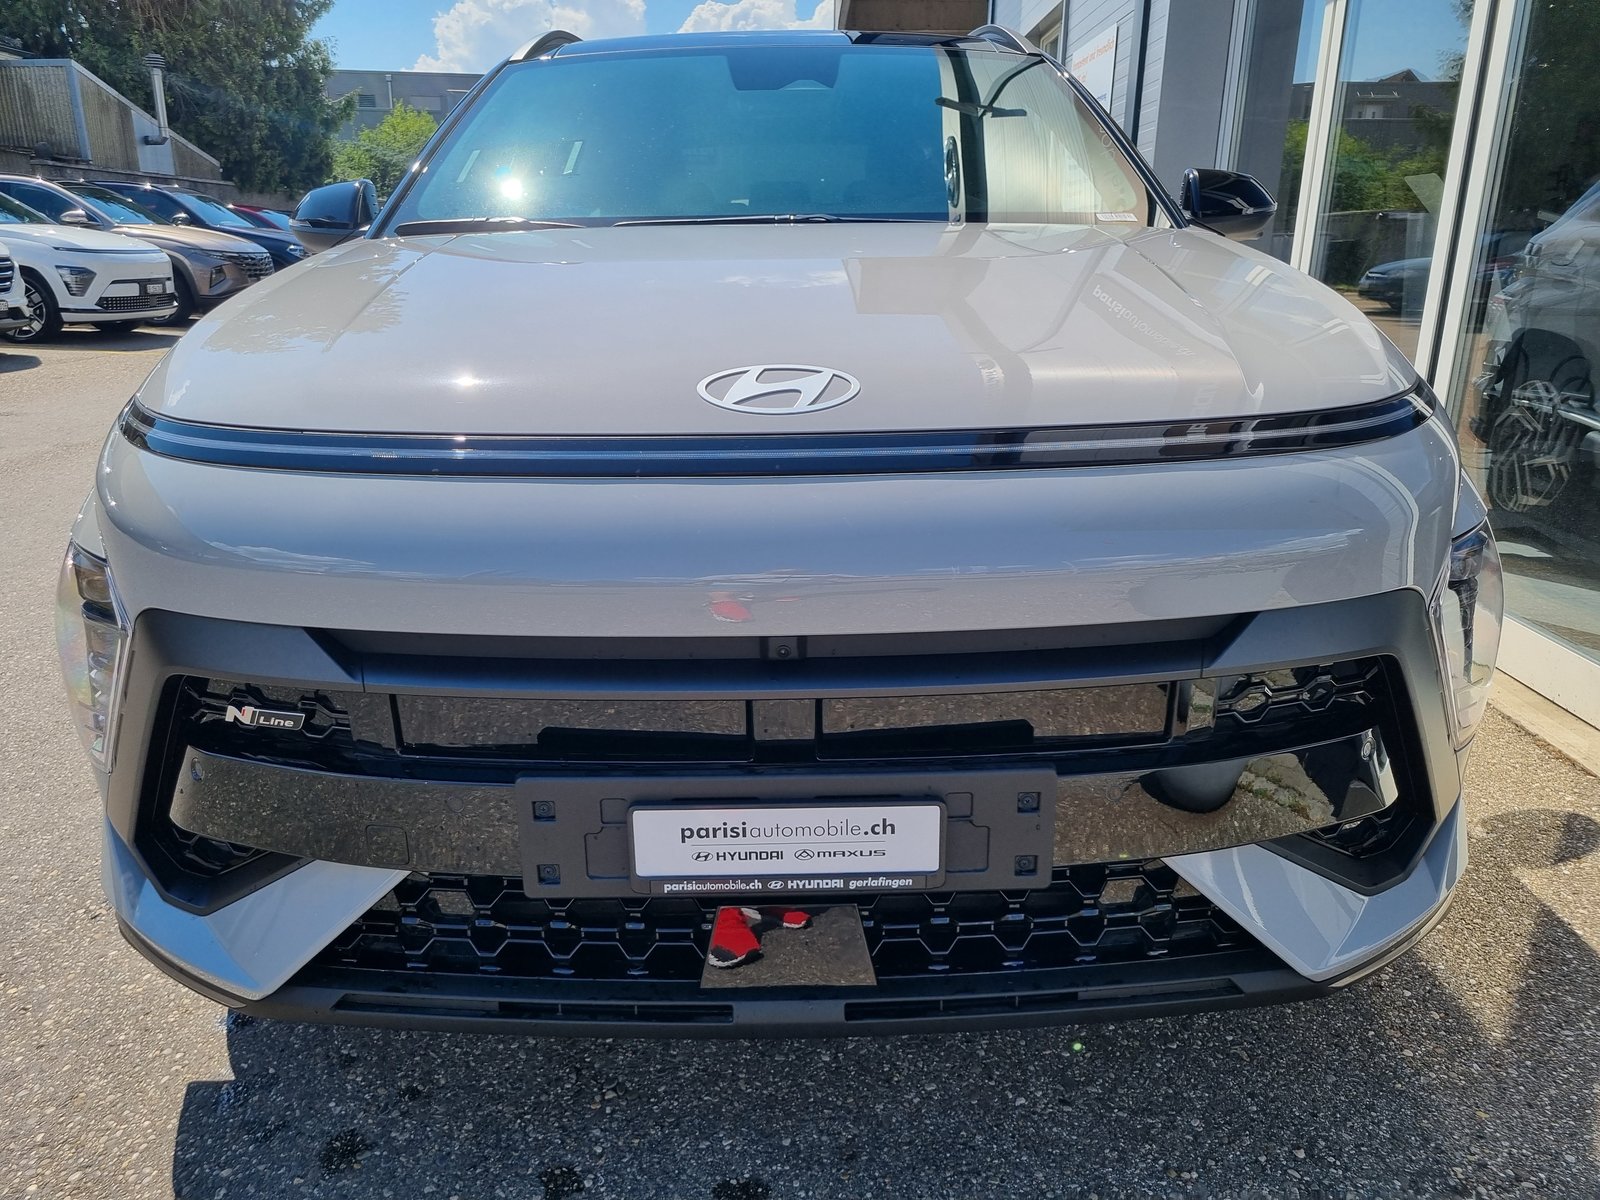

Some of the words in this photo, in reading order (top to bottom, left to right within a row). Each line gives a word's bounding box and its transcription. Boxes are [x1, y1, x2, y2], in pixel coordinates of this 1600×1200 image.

[225, 705, 255, 725] N
[259, 716, 294, 728] Line
[680, 817, 896, 844] parisiautomobile.ch
[716, 850, 784, 861] HYUNDAI
[663, 879, 762, 894] parisiautomobile.ch
[787, 879, 844, 889] HYUNDAI
[849, 877, 913, 889] gerlafingen
